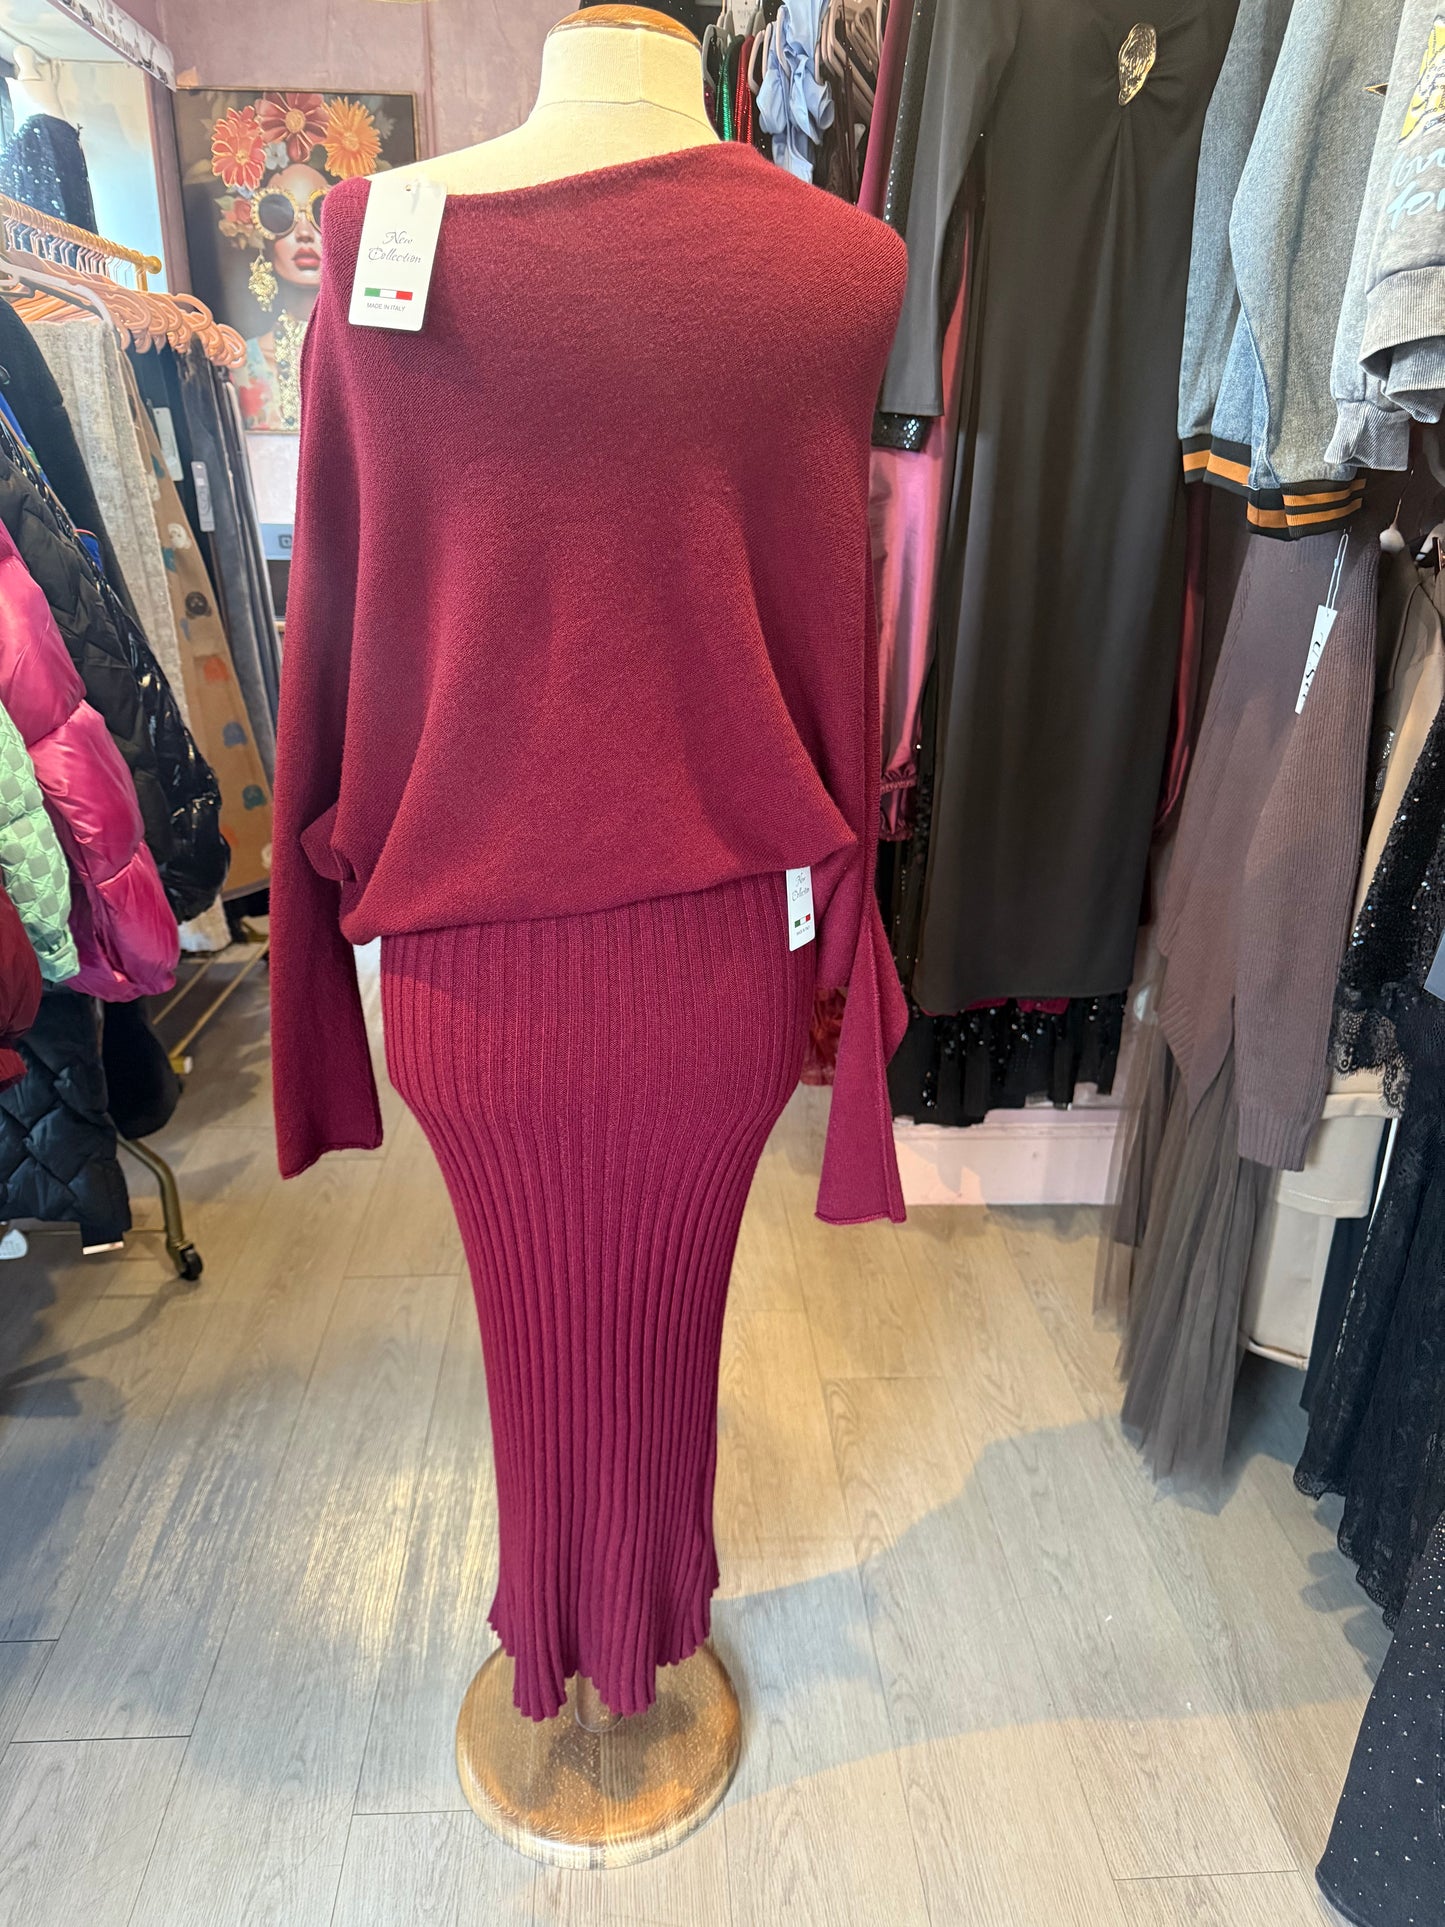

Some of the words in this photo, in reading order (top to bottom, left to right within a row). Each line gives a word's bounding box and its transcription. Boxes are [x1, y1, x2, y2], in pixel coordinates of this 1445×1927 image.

[382, 230, 414, 245] New
[368, 246, 422, 264] Collection
[366, 302, 383, 310] MADE
[390, 304, 406, 312] ITALY
